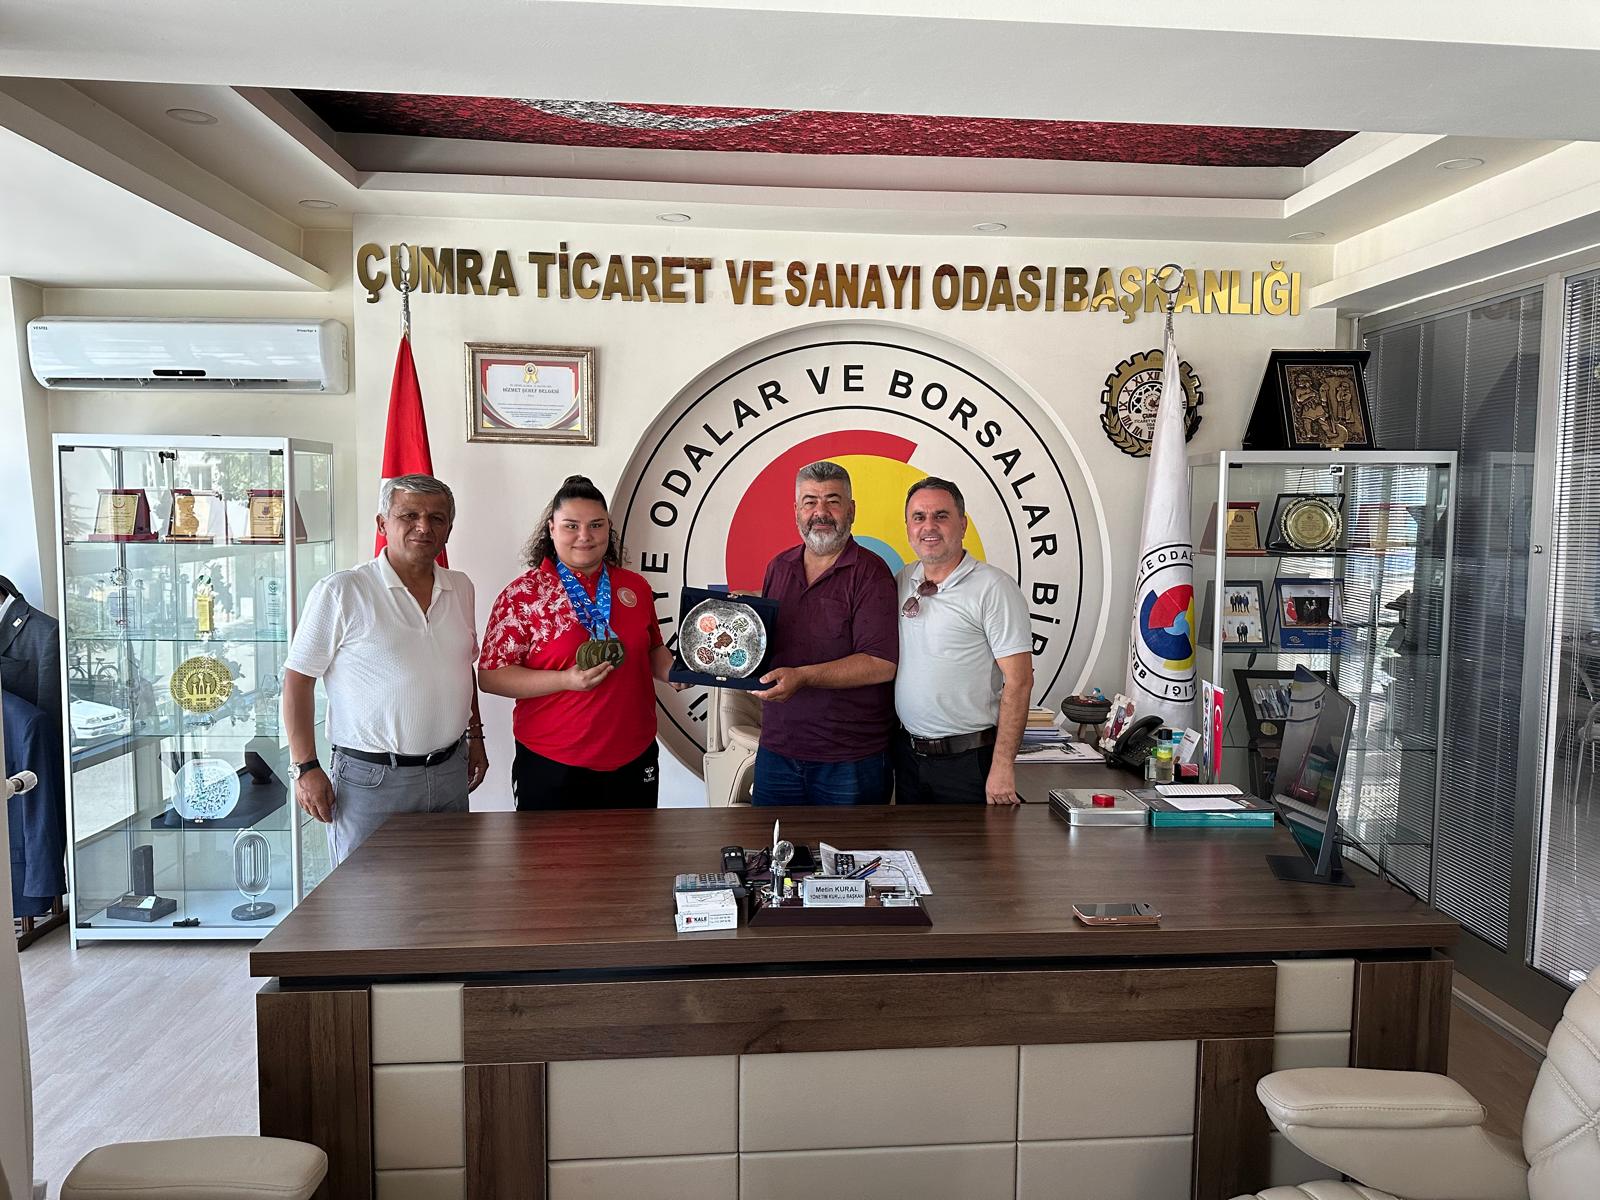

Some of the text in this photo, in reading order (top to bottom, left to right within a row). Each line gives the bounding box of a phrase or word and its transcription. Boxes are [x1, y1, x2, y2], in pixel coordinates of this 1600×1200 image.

[356, 241, 1302, 324] ÇUMRA TİCARET VE SANAYI ODASI BAŞKANLIĞI
[650, 380, 790, 528] ODALAR
[805, 364, 865, 395] VE
[888, 369, 1058, 560] BORSALAR
